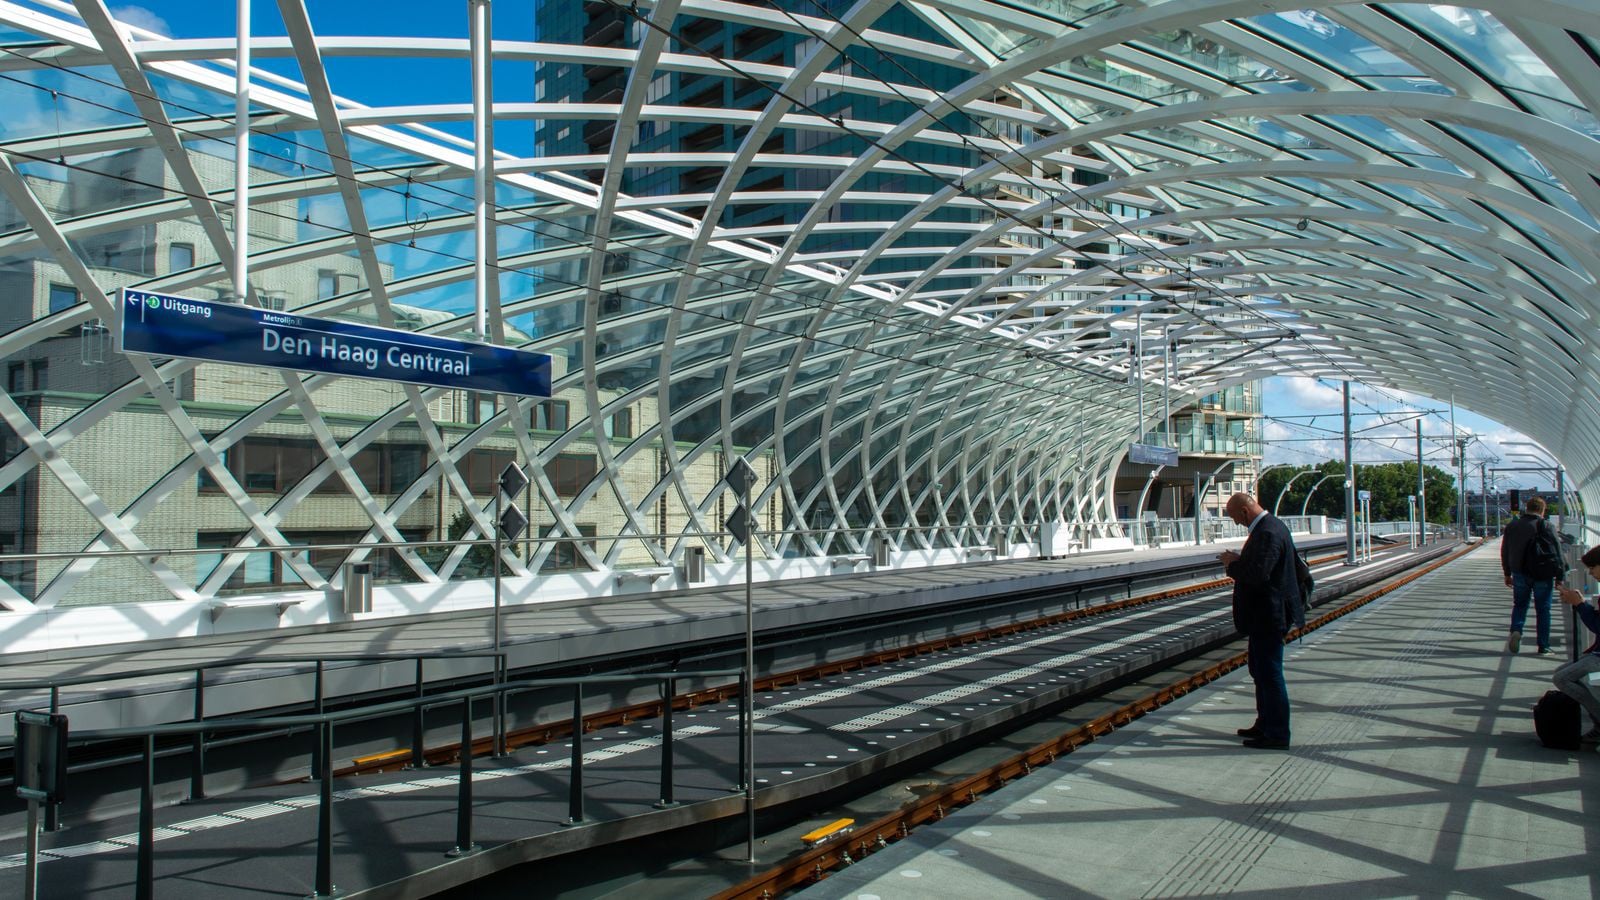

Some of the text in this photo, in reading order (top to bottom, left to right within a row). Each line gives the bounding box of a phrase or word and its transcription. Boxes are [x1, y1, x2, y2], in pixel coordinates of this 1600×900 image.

[163, 299, 211, 317] Uitgang
[263, 314, 295, 325] Metrolijn
[262, 328, 470, 376] Den Haag Centraal
